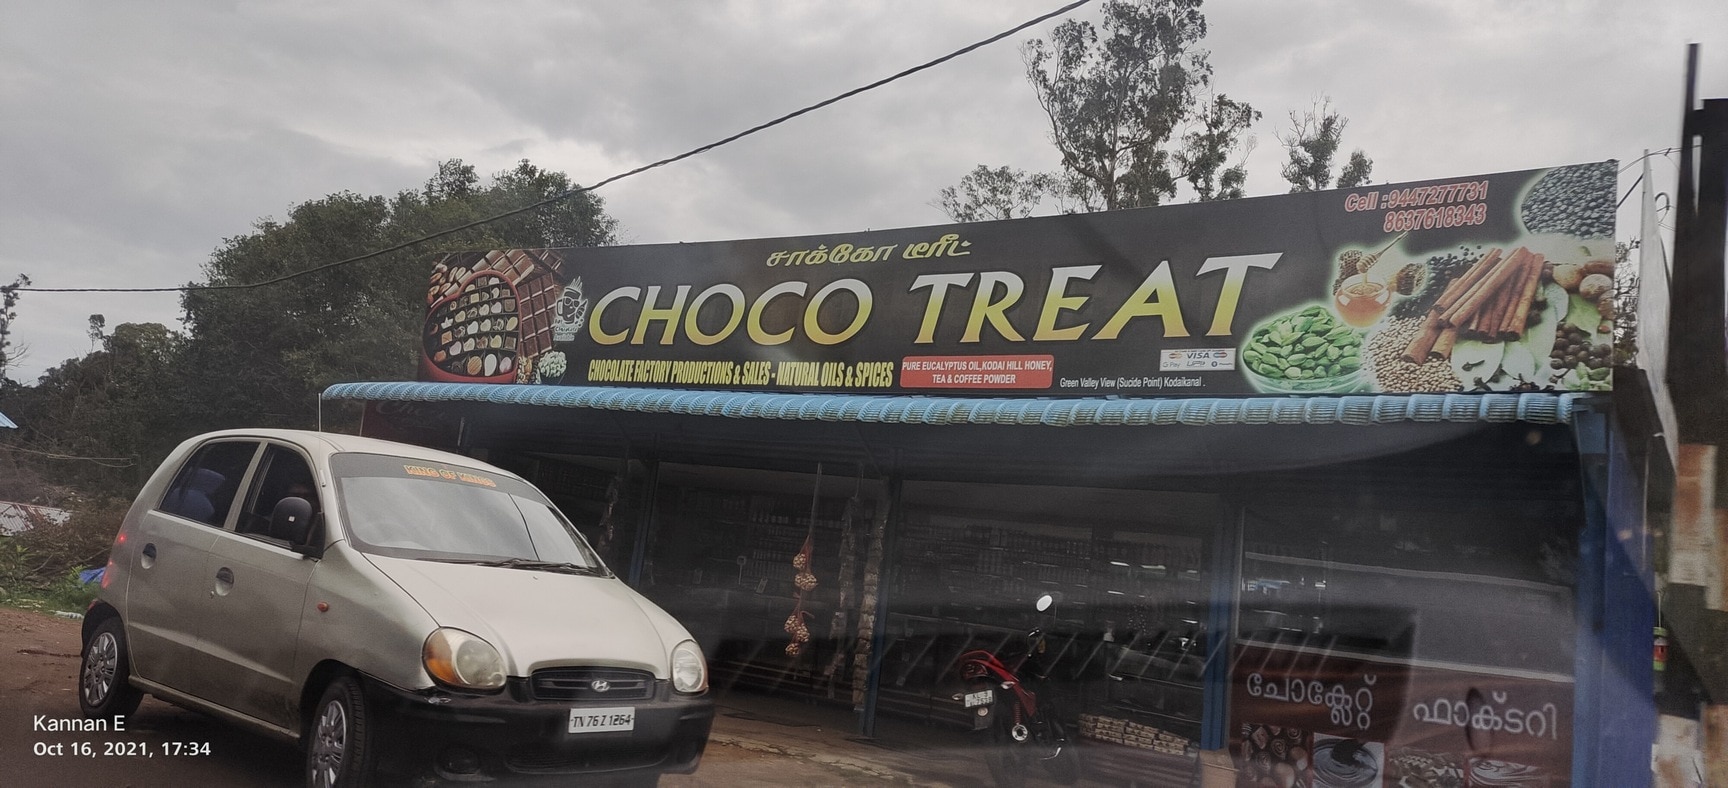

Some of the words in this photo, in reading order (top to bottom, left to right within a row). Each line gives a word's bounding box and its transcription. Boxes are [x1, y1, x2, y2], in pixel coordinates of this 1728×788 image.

[1345, 191, 1379, 212] Cell
[1383, 203, 1488, 232] 8637618343
[766, 243, 898, 267] சாக்கோ
[588, 278, 873, 346] CHOCO
[909, 252, 1284, 344] TREAT
[588, 359, 635, 382] CHOCOLATE
[633, 360, 673, 383] FACTORY
[670, 361, 734, 384] PRODUCTIONS
[733, 365, 741, 384] &
[742, 361, 771, 386] SALES
[776, 361, 819, 386] NATURAL
[820, 361, 845, 387] OILS
[845, 365, 853, 387] &
[854, 361, 894, 387] SPICES
[902, 361, 921, 371] PURE
[922, 361, 967, 371] EUCALYPTUS
[1006, 360, 1023, 370] HILL
[1024, 360, 1052, 372] HONEY,
[932, 374, 946, 384] TEA
[947, 374, 952, 384] &
[953, 374, 982, 384] COFFEE
[983, 374, 1016, 384] POWDER
[1060, 377, 1079, 387] Green
[1080, 377, 1099, 390] Valley
[1100, 377, 1116, 387] View
[1116, 377, 1141, 389] (Sucide
[1142, 377, 1163, 389] Point)
[1164, 376, 1202, 387] Kodaikanal
[439, 469, 458, 480] OF
[1247, 672, 1377, 730] ചോക്ലേറ്റ്
[1413, 691, 1558, 740] ഫാക്ടറി
[573, 716, 586, 728] TN
[587, 715, 600, 727] 76
[600, 715, 607, 726] Z
[609, 714, 632, 726] 1264
